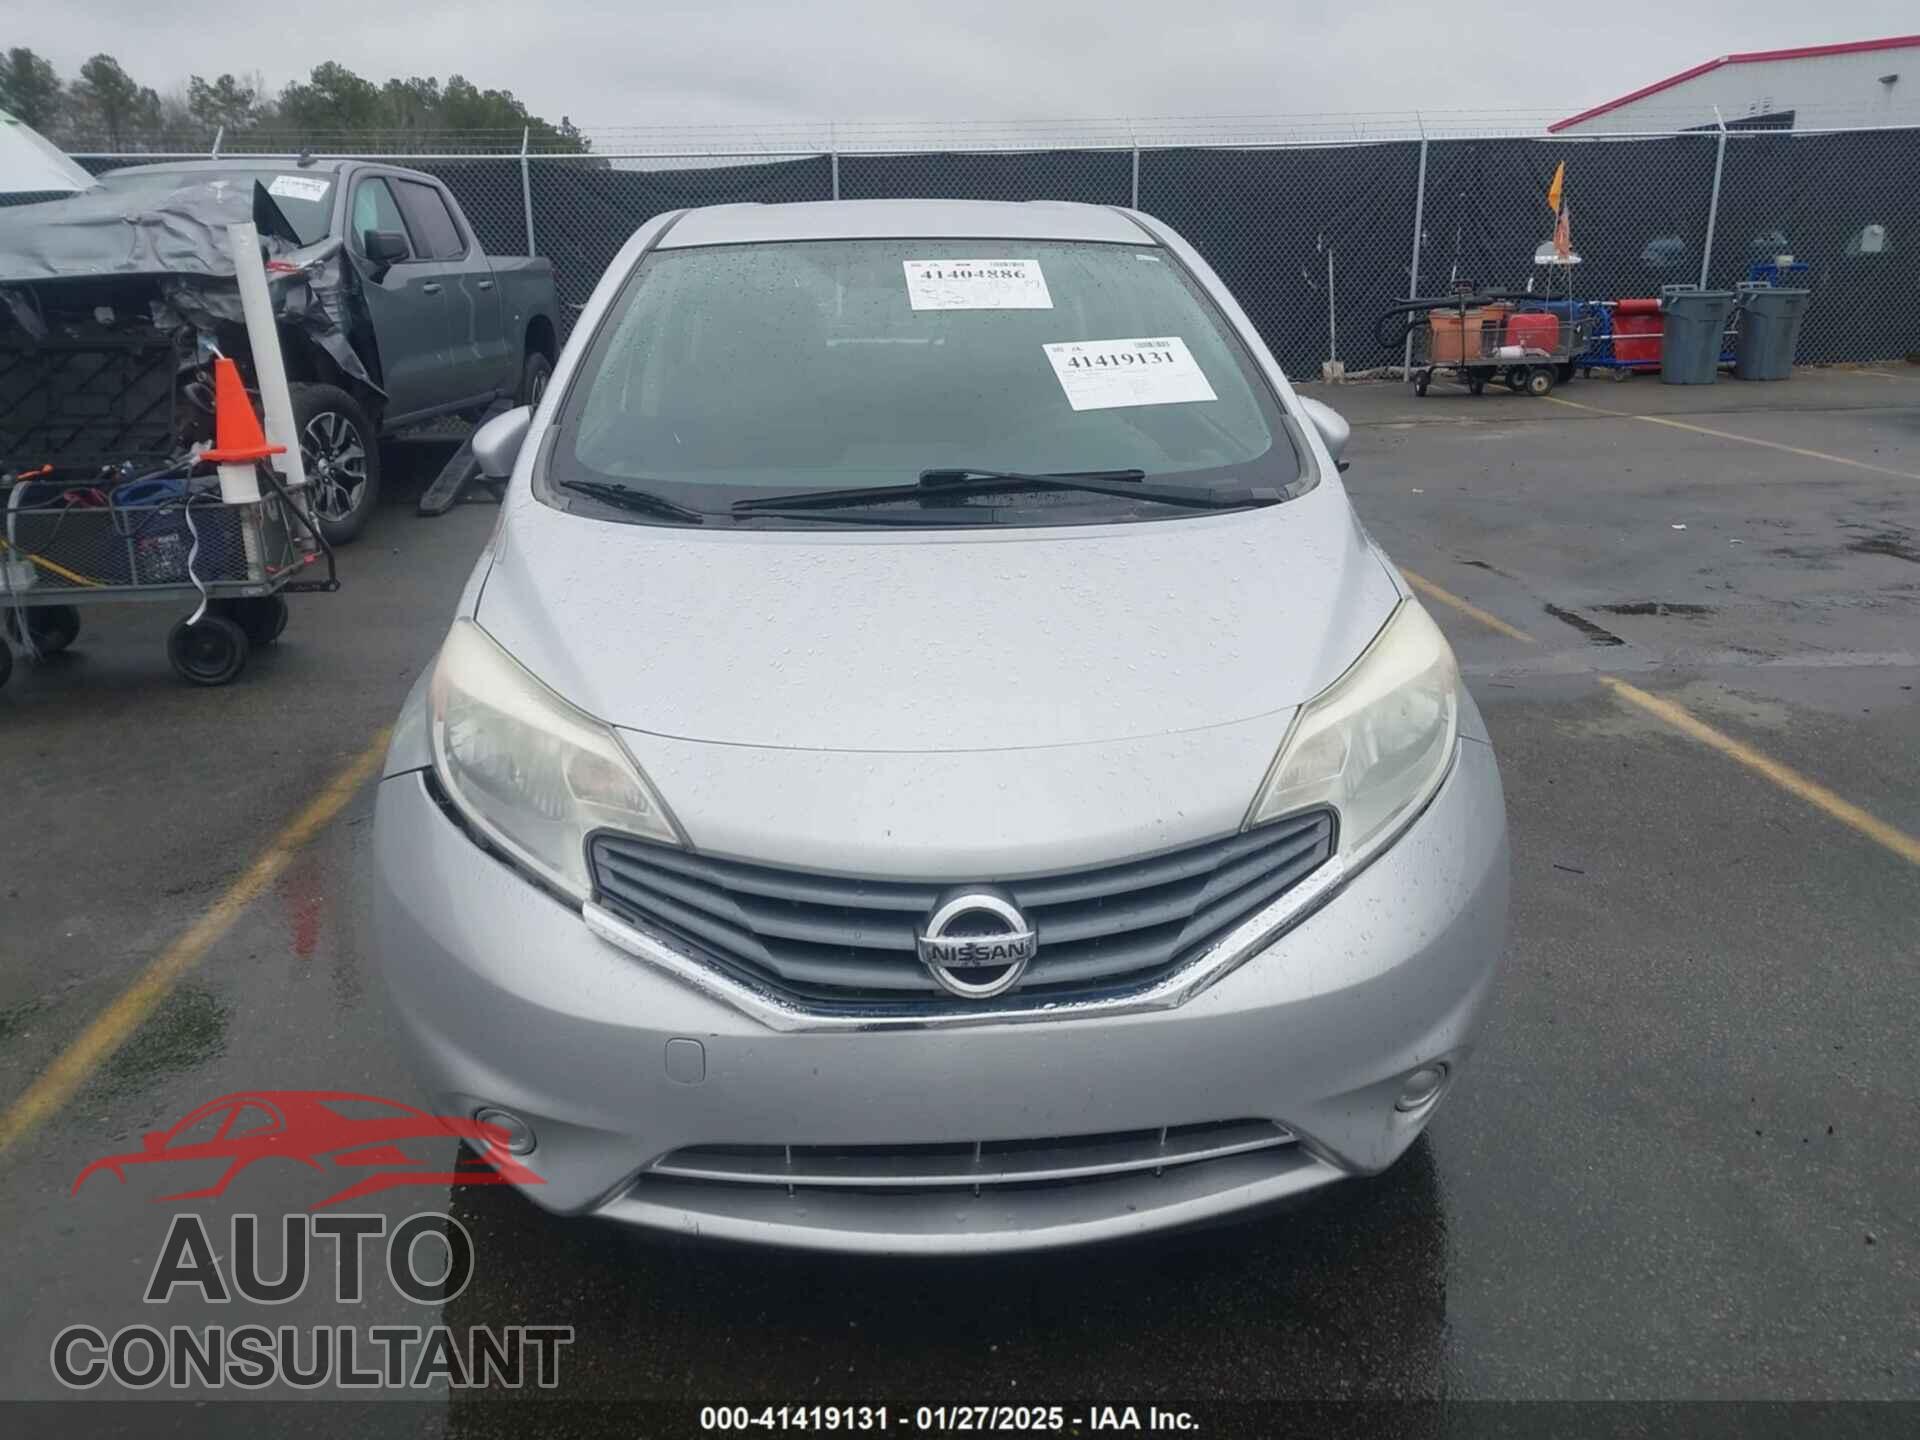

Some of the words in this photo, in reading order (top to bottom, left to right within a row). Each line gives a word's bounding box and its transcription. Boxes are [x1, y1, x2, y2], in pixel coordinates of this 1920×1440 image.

[920, 269, 1026, 280] 41404886
[1068, 351, 1174, 368] 41419131
[931, 943, 1025, 961] NISSAN
